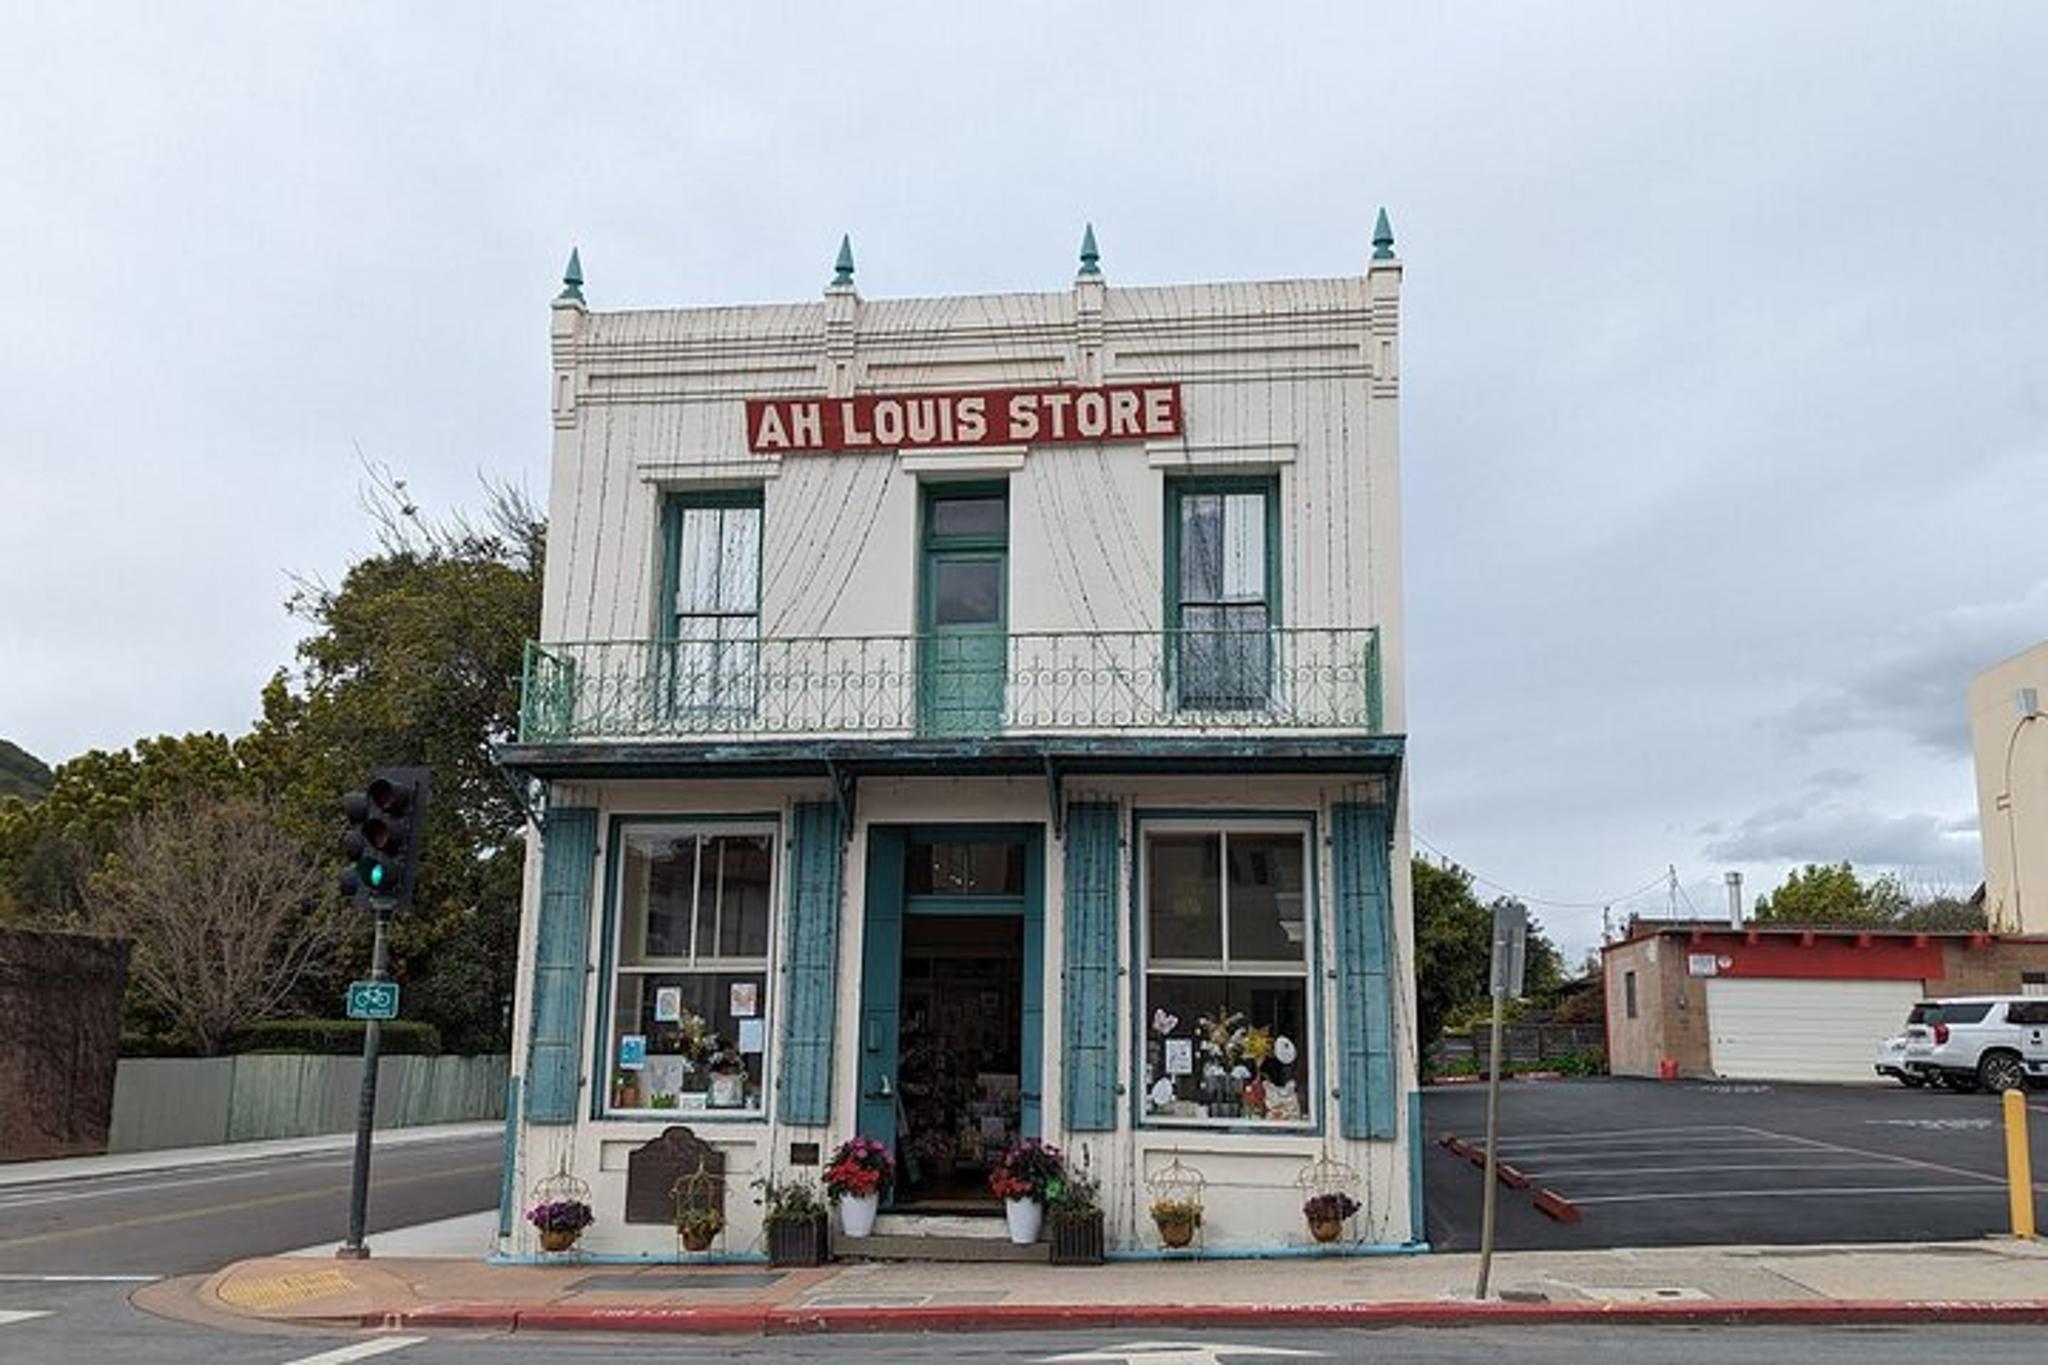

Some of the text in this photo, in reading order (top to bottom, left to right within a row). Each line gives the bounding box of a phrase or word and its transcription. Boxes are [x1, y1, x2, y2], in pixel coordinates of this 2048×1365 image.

[755, 389, 1175, 448] AH LOUIS STORE
